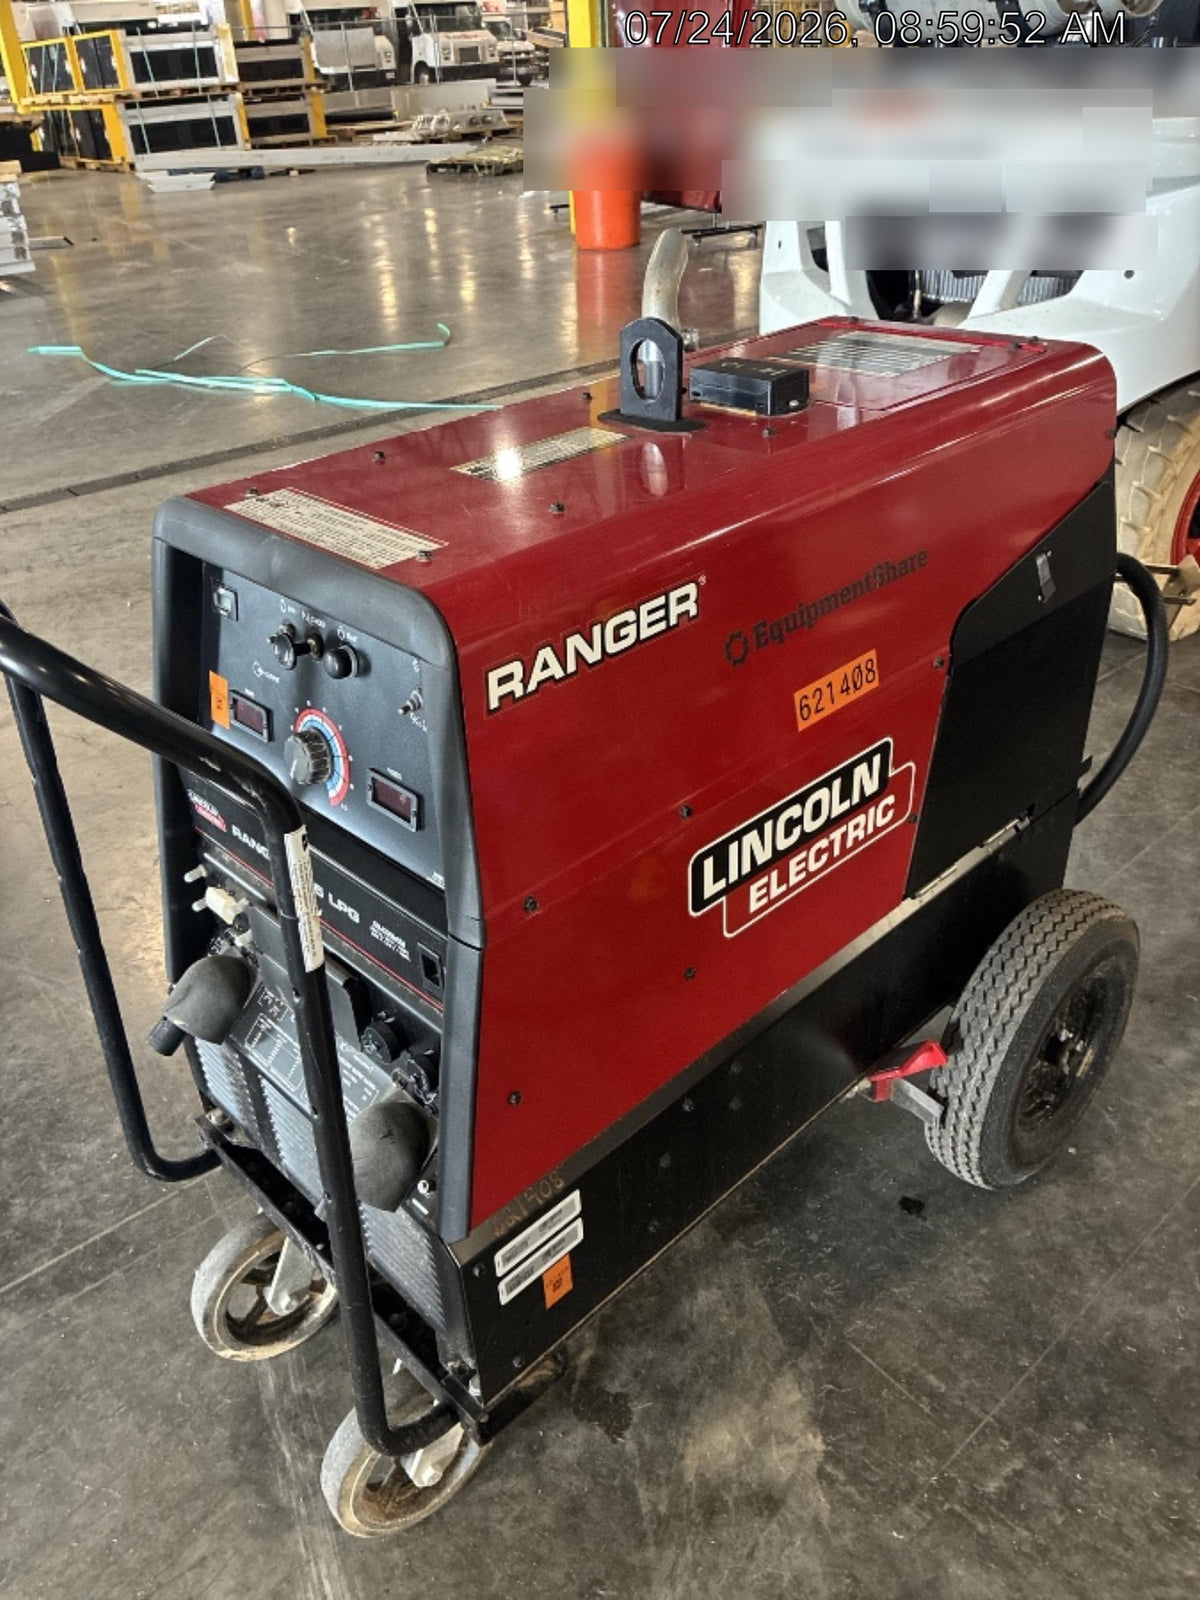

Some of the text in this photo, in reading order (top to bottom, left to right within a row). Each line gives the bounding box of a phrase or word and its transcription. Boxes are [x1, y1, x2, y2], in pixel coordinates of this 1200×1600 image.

[487, 581, 700, 712] RANGER
[752, 549, 929, 651] EquipmentShare
[798, 657, 877, 722] 621408
[702, 753, 883, 902] LINCOLN
[748, 793, 897, 915] ELECTRIC
